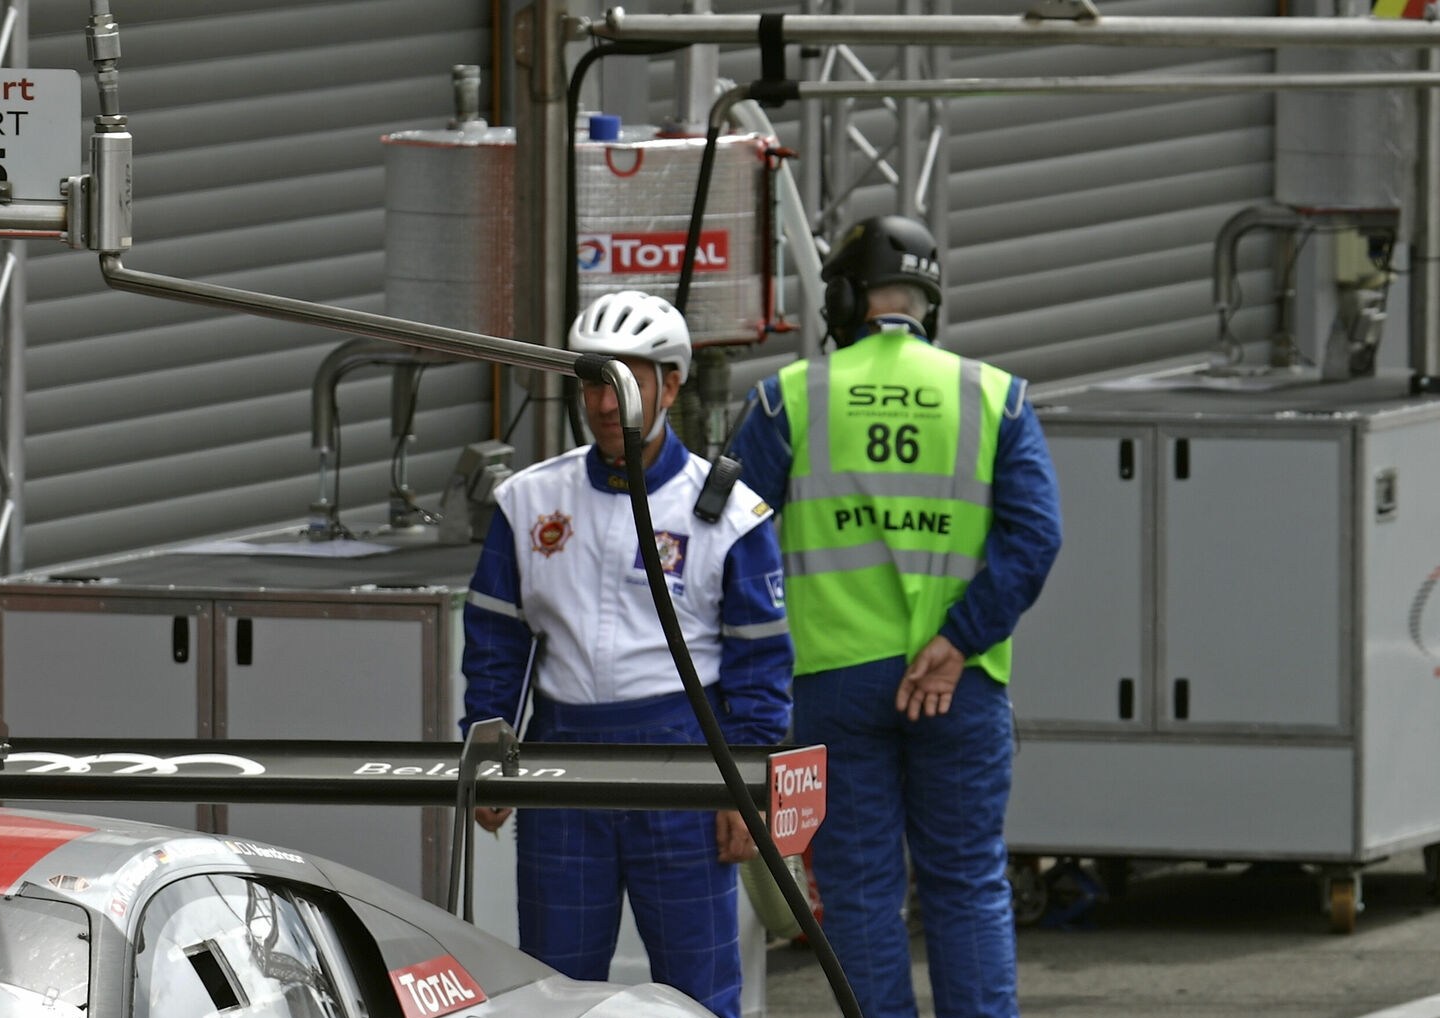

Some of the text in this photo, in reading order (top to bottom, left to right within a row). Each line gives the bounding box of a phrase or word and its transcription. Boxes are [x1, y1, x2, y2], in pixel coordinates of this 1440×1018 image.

[866, 422, 920, 464] 86
[835, 505, 952, 534] PIT LANE
[774, 764, 823, 797] TOTAL
[398, 969, 476, 1016] TOTAL
